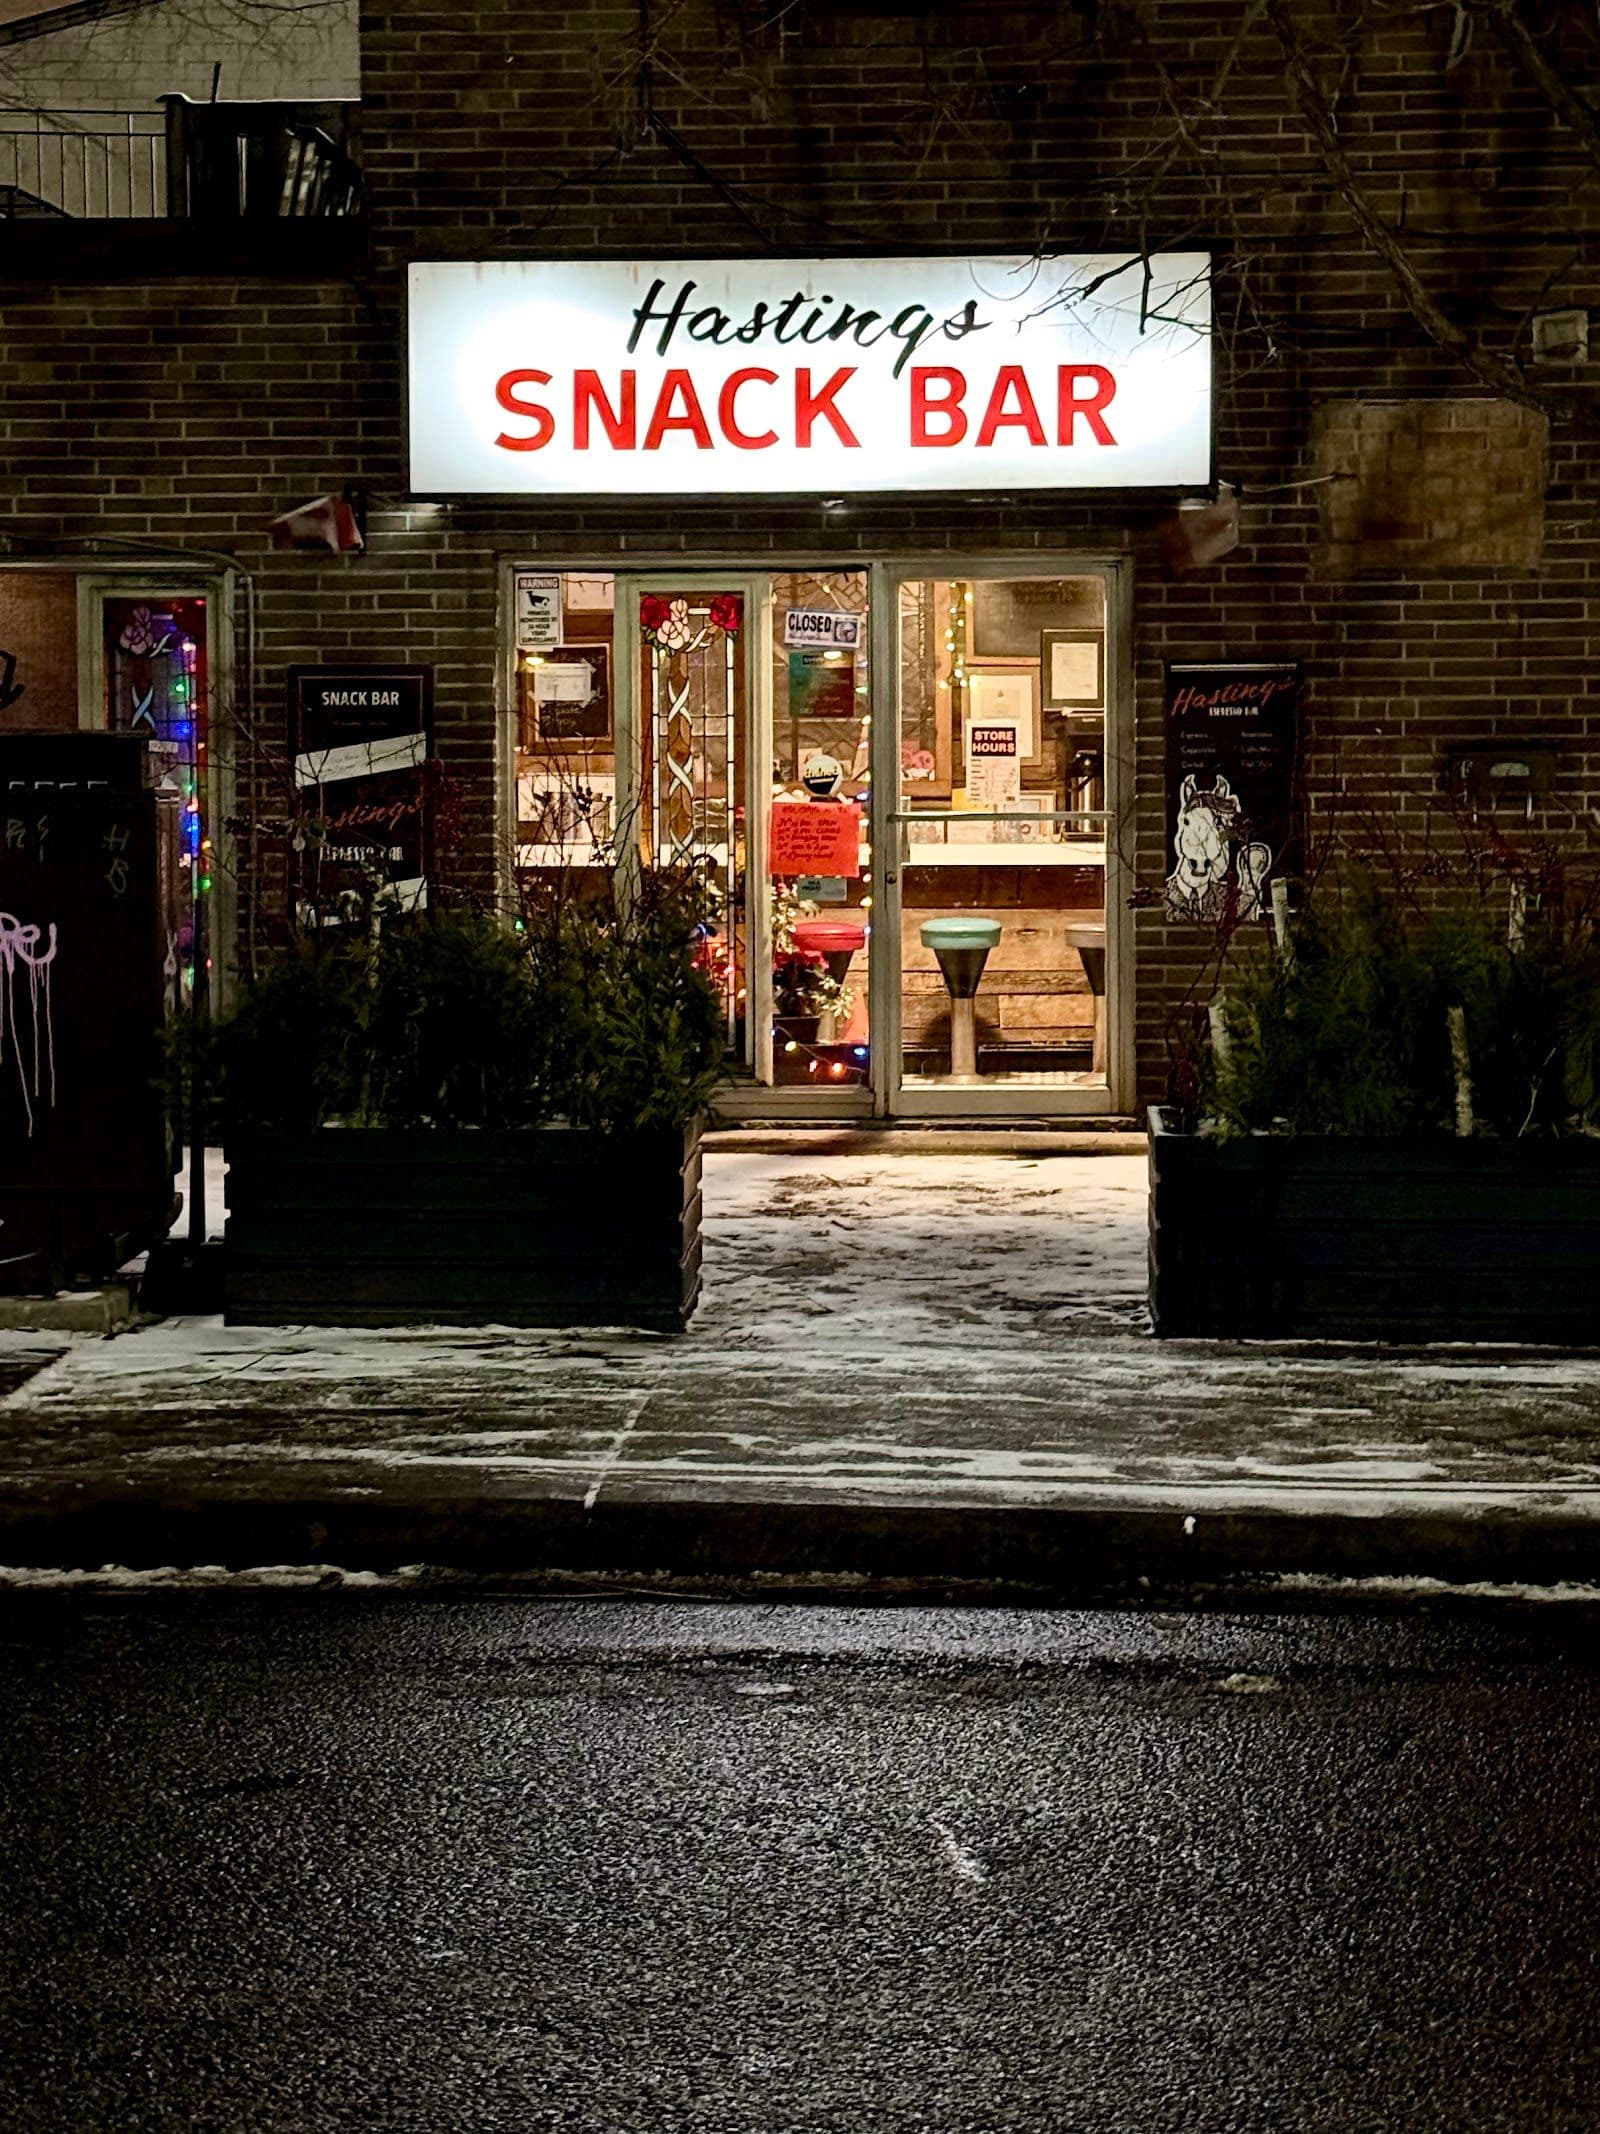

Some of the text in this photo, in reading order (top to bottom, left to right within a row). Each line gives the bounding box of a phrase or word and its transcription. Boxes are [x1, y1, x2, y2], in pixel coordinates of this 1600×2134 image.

[626, 278, 993, 379] Hastings
[494, 364, 1119, 451] SNACK BAR
[519, 578, 558, 589] WARNING
[788, 613, 832, 633] CLOSED
[321, 691, 400, 706] SNACK BAR
[974, 730, 1014, 741] STORE
[972, 742, 1015, 753] HOURS
